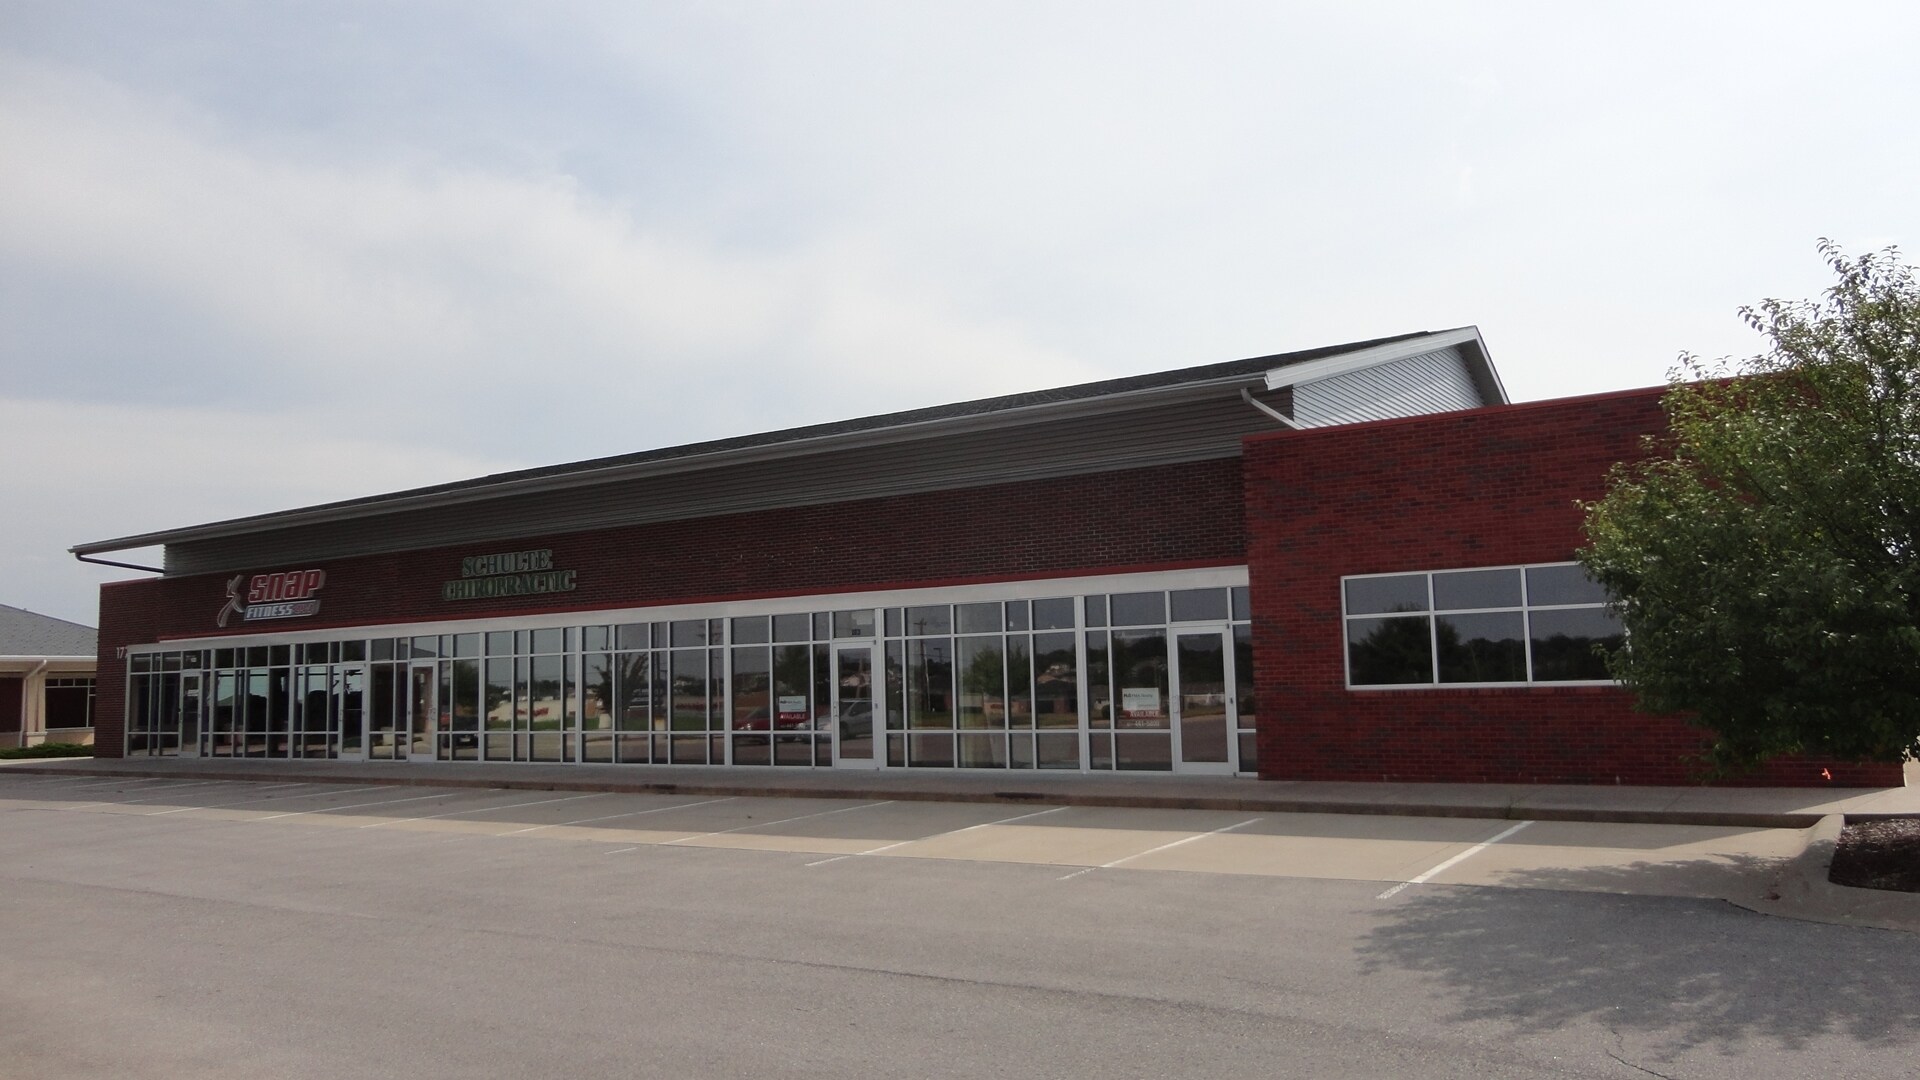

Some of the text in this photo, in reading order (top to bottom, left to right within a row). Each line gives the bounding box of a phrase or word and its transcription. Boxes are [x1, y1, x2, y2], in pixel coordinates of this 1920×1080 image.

[462, 549, 553, 577] SCHULTE
[442, 570, 577, 601] CHIROPRACTIC
[246, 604, 294, 619] FITNESS
